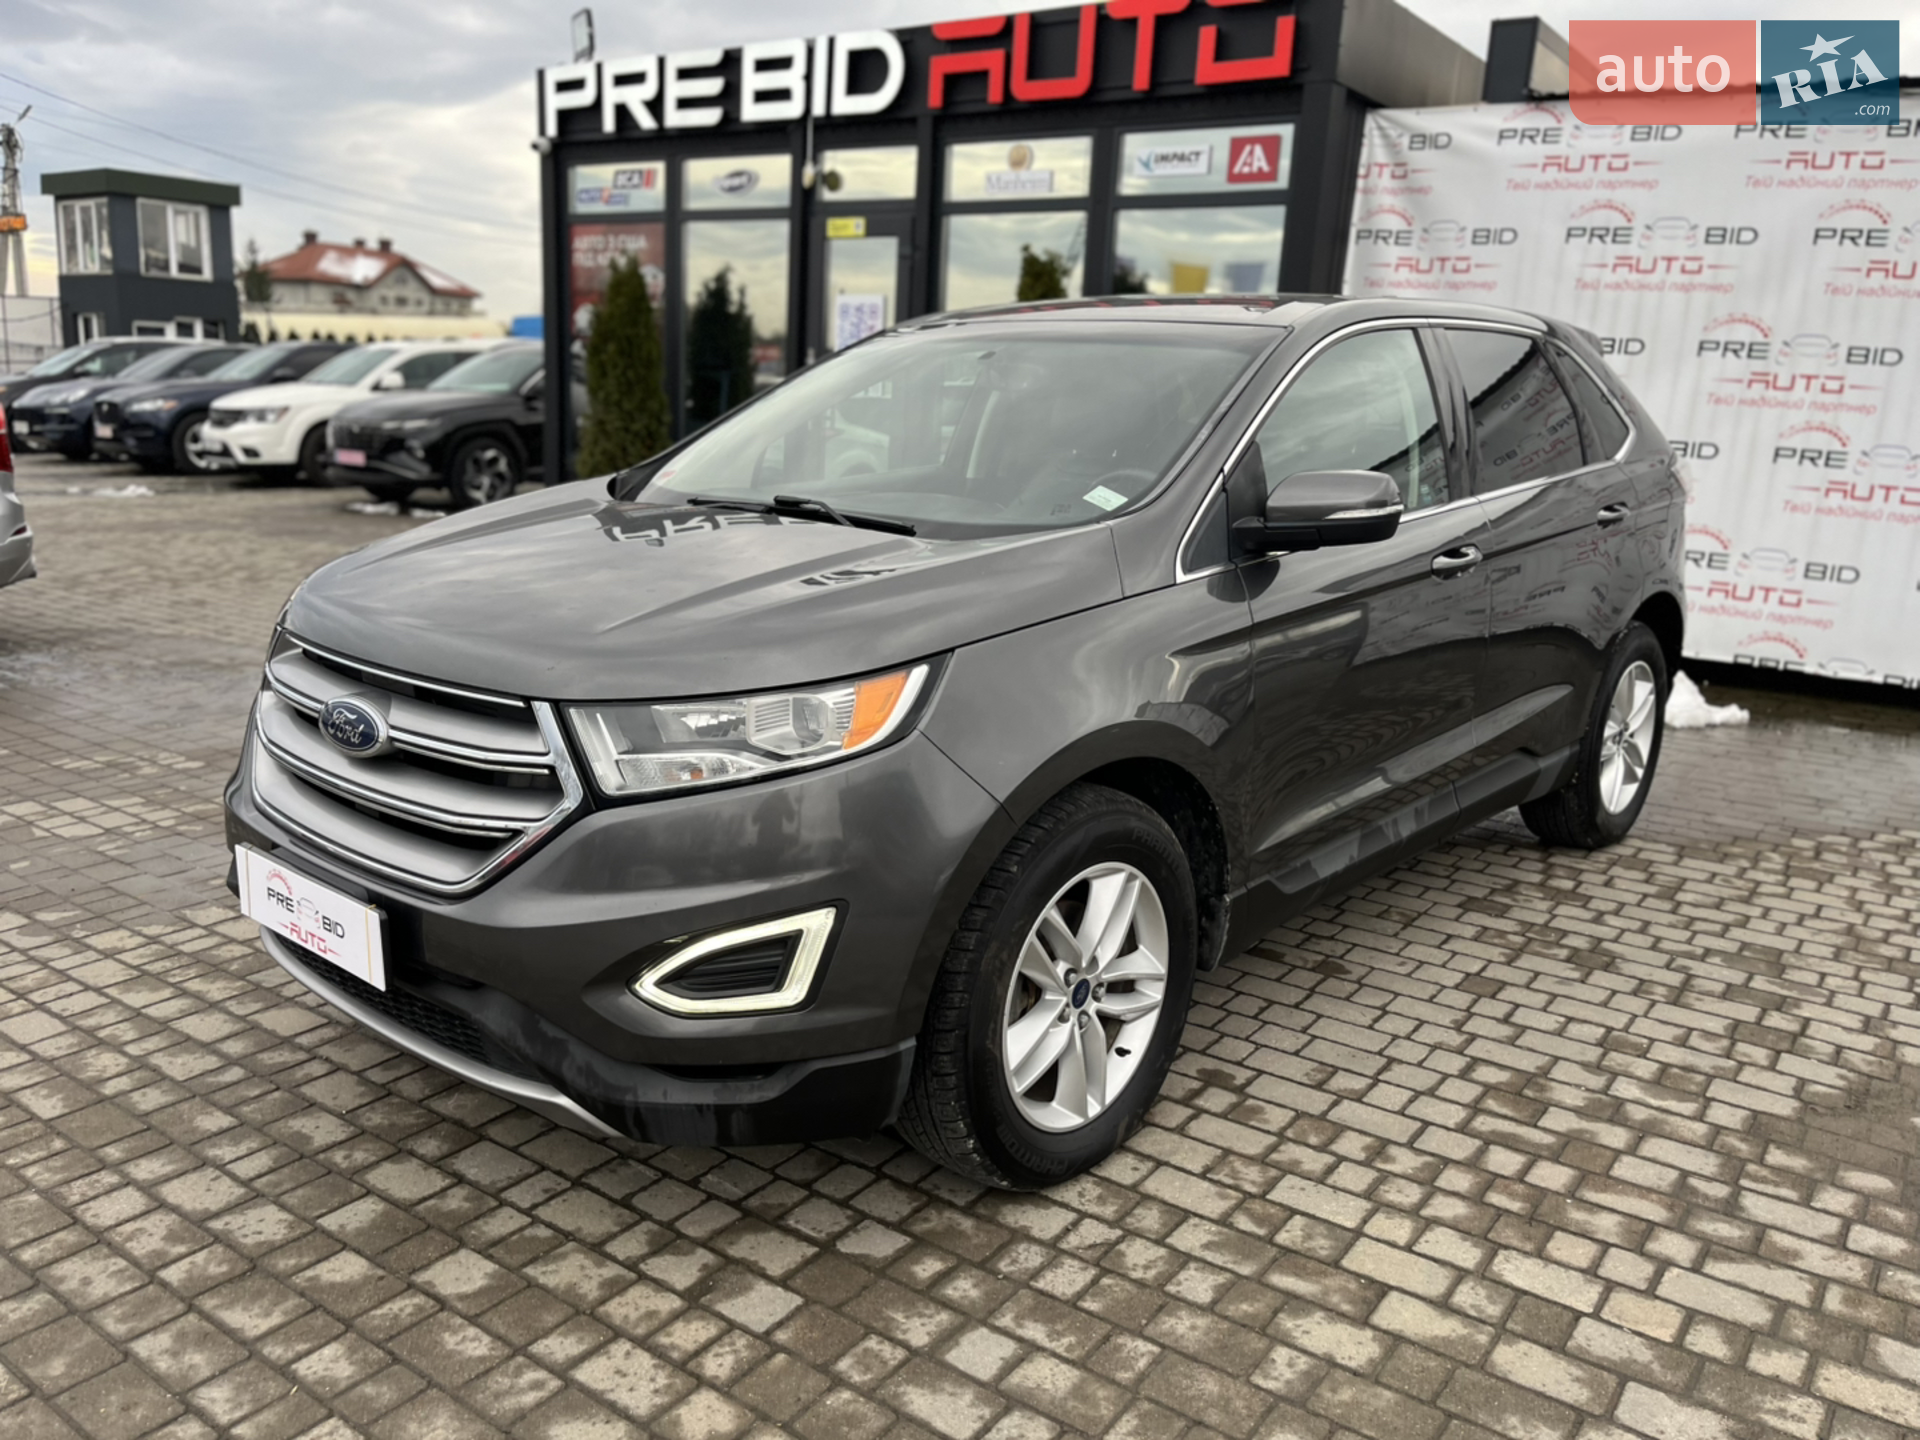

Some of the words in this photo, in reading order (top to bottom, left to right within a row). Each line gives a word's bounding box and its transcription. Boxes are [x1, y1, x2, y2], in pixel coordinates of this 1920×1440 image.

[545, 48, 725, 137] PRE
[740, 29, 905, 123] BID
[927, 0, 1296, 108] AUTO
[1497, 127, 1563, 146] PRE
[1629, 123, 1682, 142] BID
[1734, 120, 1808, 140] PRE
[1886, 118, 1920, 139] BI
[1408, 133, 1452, 151] BID
[1541, 153, 1630, 174] AUTO
[1785, 150, 1886, 171] AUTO
[1354, 229, 1414, 247] PRE
[1471, 227, 1518, 245] BID
[1564, 226, 1634, 245] PRE
[1703, 226, 1759, 246] BID
[1812, 227, 1891, 248] PRE
[1394, 256, 1472, 275] AUTO
[1611, 255, 1703, 275] AUTO
[1865, 259, 1919, 280] AU
[1696, 339, 1771, 360] PRE
[1845, 346, 1904, 367] BID
[1747, 371, 1845, 395] AUTO
[1772, 446, 1850, 469] PRE
[1685, 550, 1730, 571] RE
[1803, 562, 1861, 584] BID
[1707, 580, 1803, 608] AUTO
[328, 708, 365, 744] Ford
[267, 887, 295, 914] PRE
[322, 915, 345, 939] BID
[290, 921, 328, 955] AUTO
